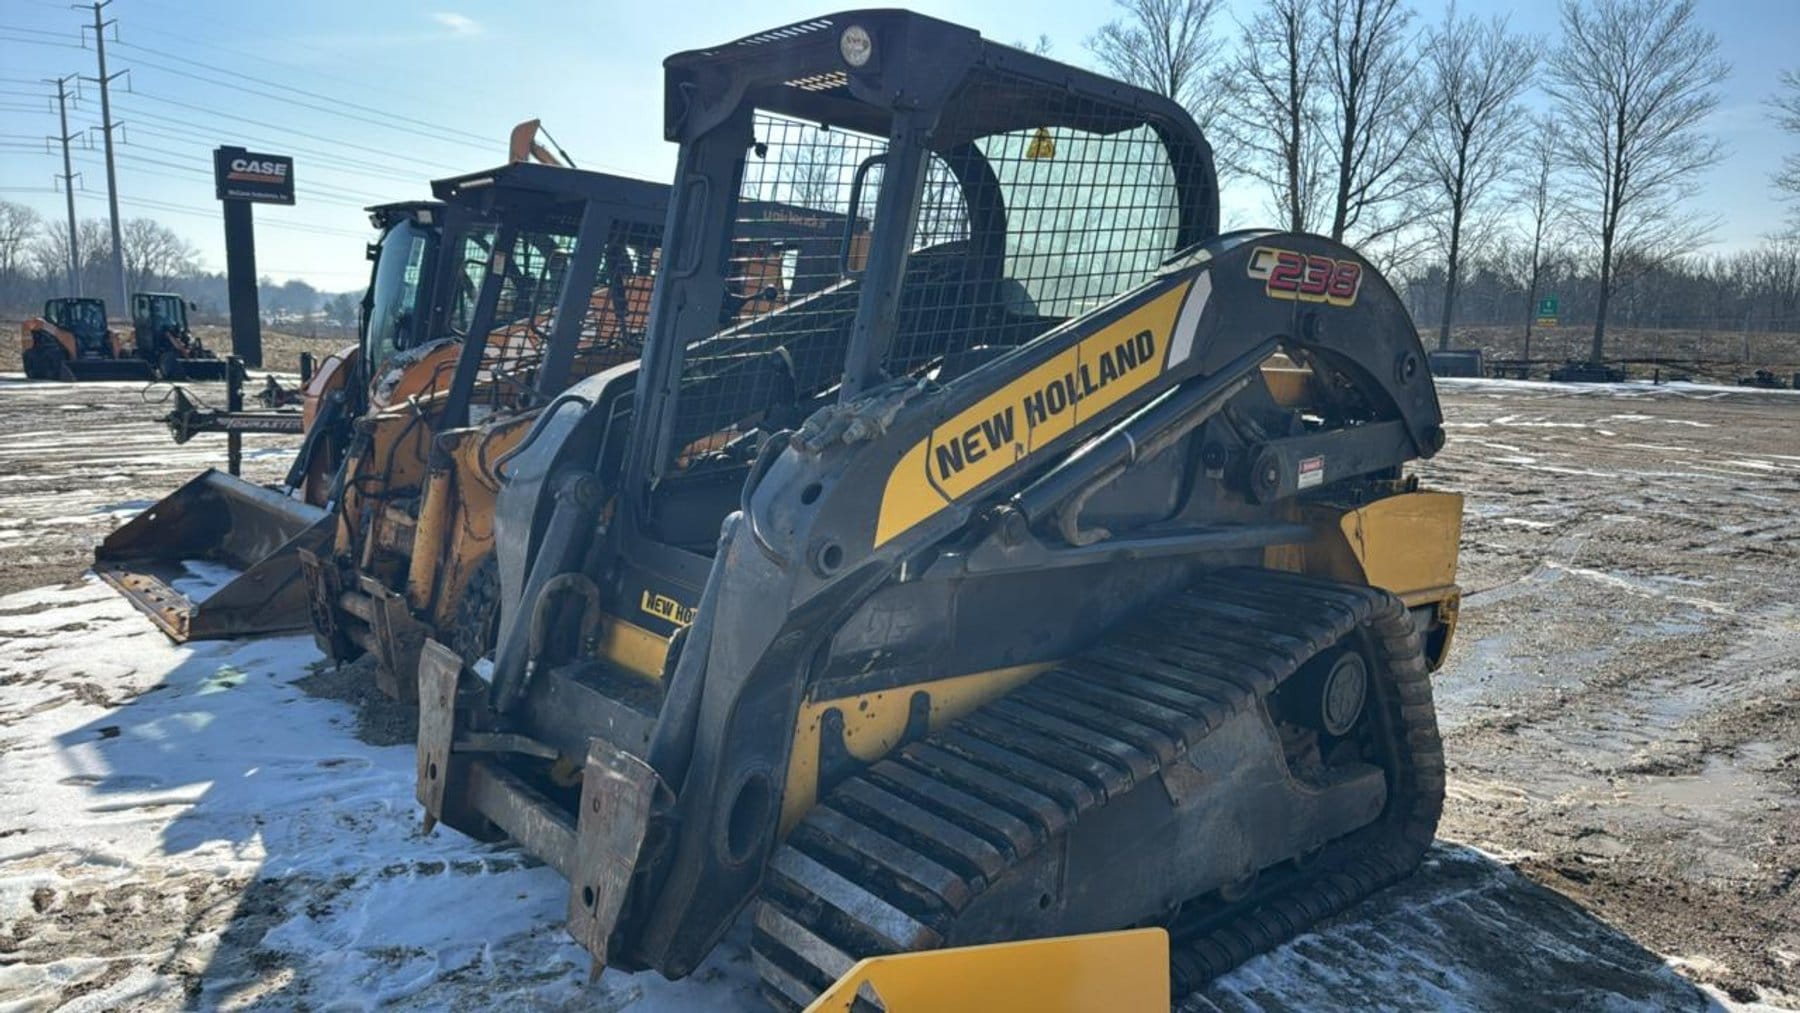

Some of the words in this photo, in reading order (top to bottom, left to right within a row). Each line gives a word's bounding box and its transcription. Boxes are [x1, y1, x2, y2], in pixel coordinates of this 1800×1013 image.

[231, 158, 288, 176] CASE
[935, 408, 1014, 481] NEW
[1023, 329, 1155, 429] HOLLAND
[646, 594, 674, 617] NEW
